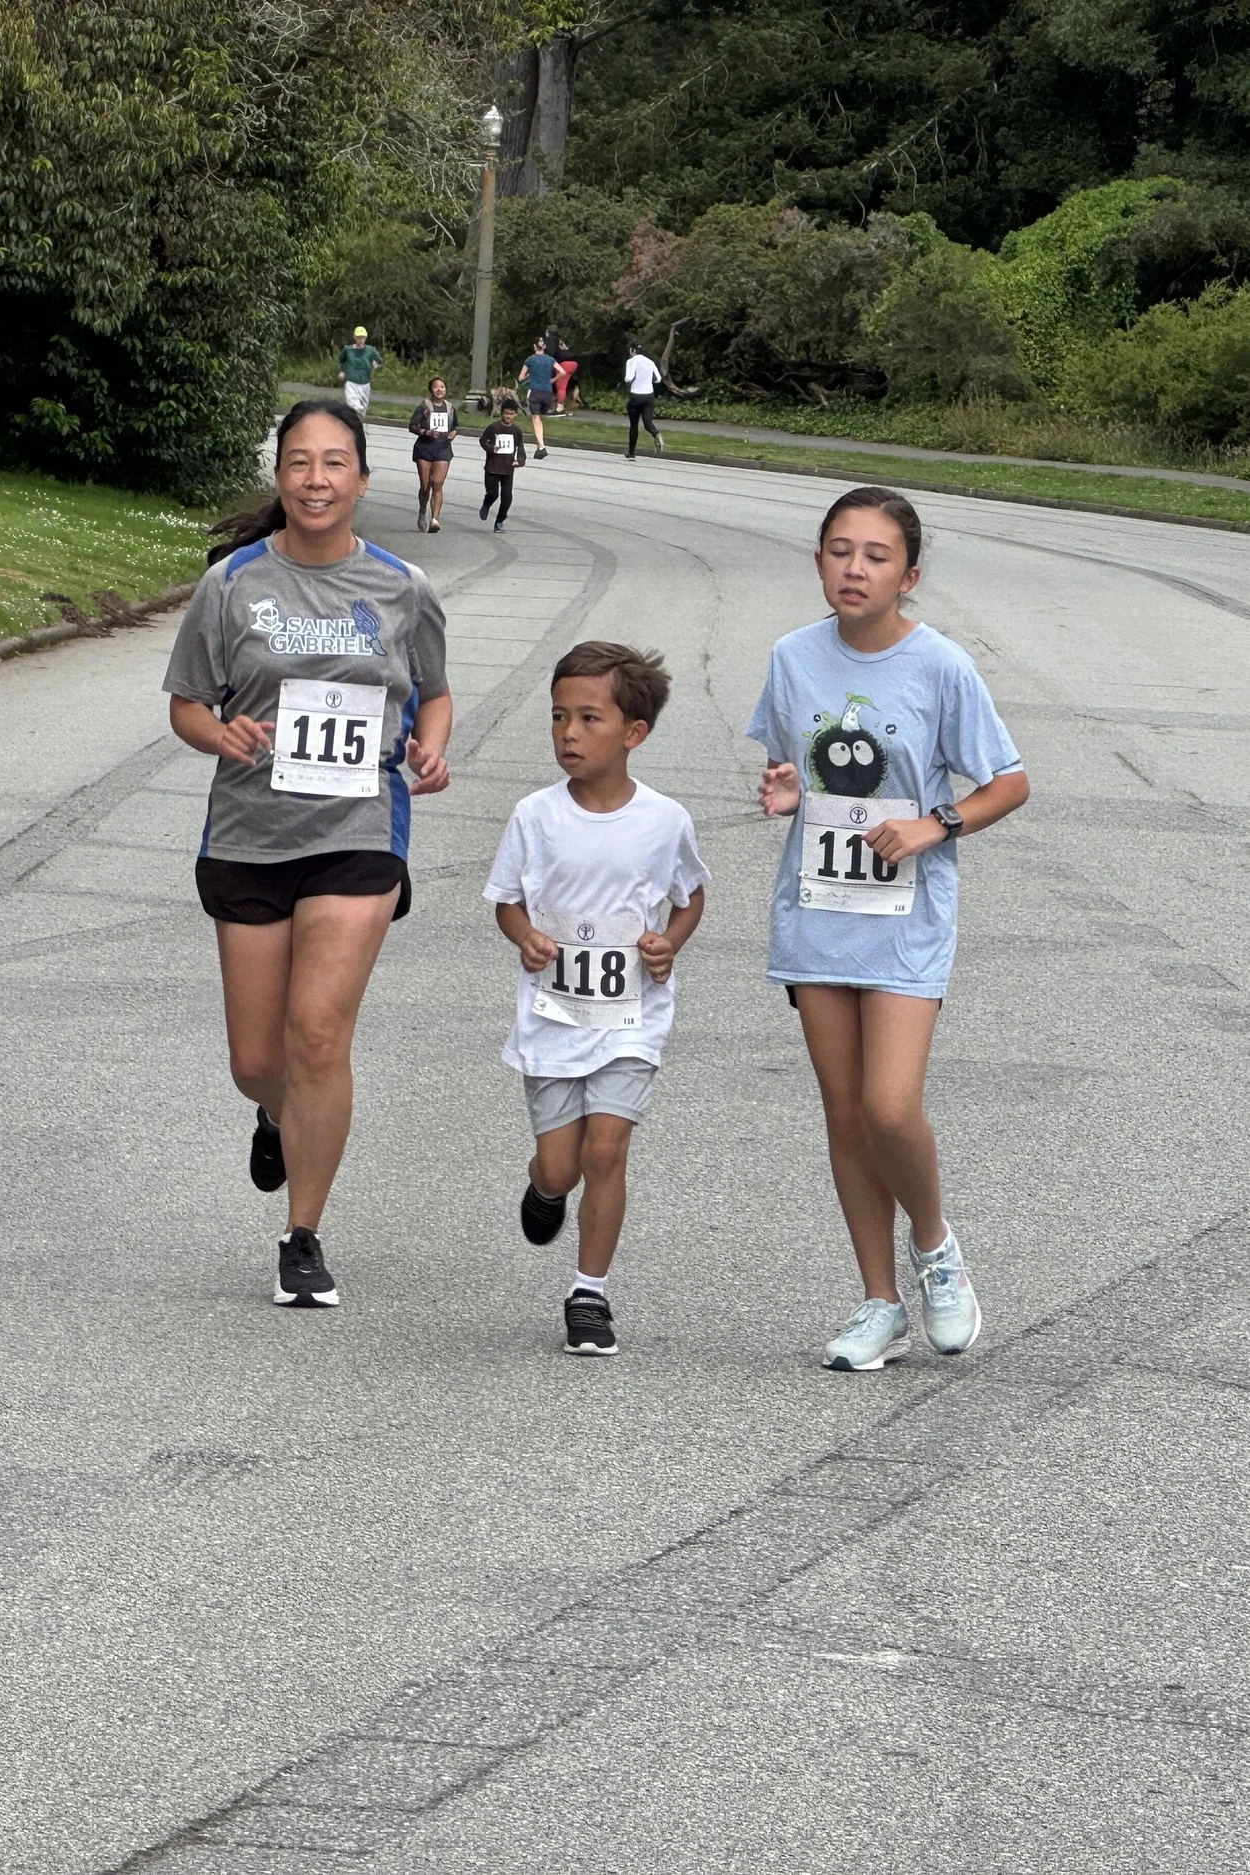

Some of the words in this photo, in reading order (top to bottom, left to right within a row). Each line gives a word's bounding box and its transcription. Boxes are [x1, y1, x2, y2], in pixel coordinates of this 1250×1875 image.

[268, 632, 373, 656] GABRIEL
[287, 617, 355, 636] SAINT
[290, 715, 368, 765] 115
[551, 947, 626, 997] 118
